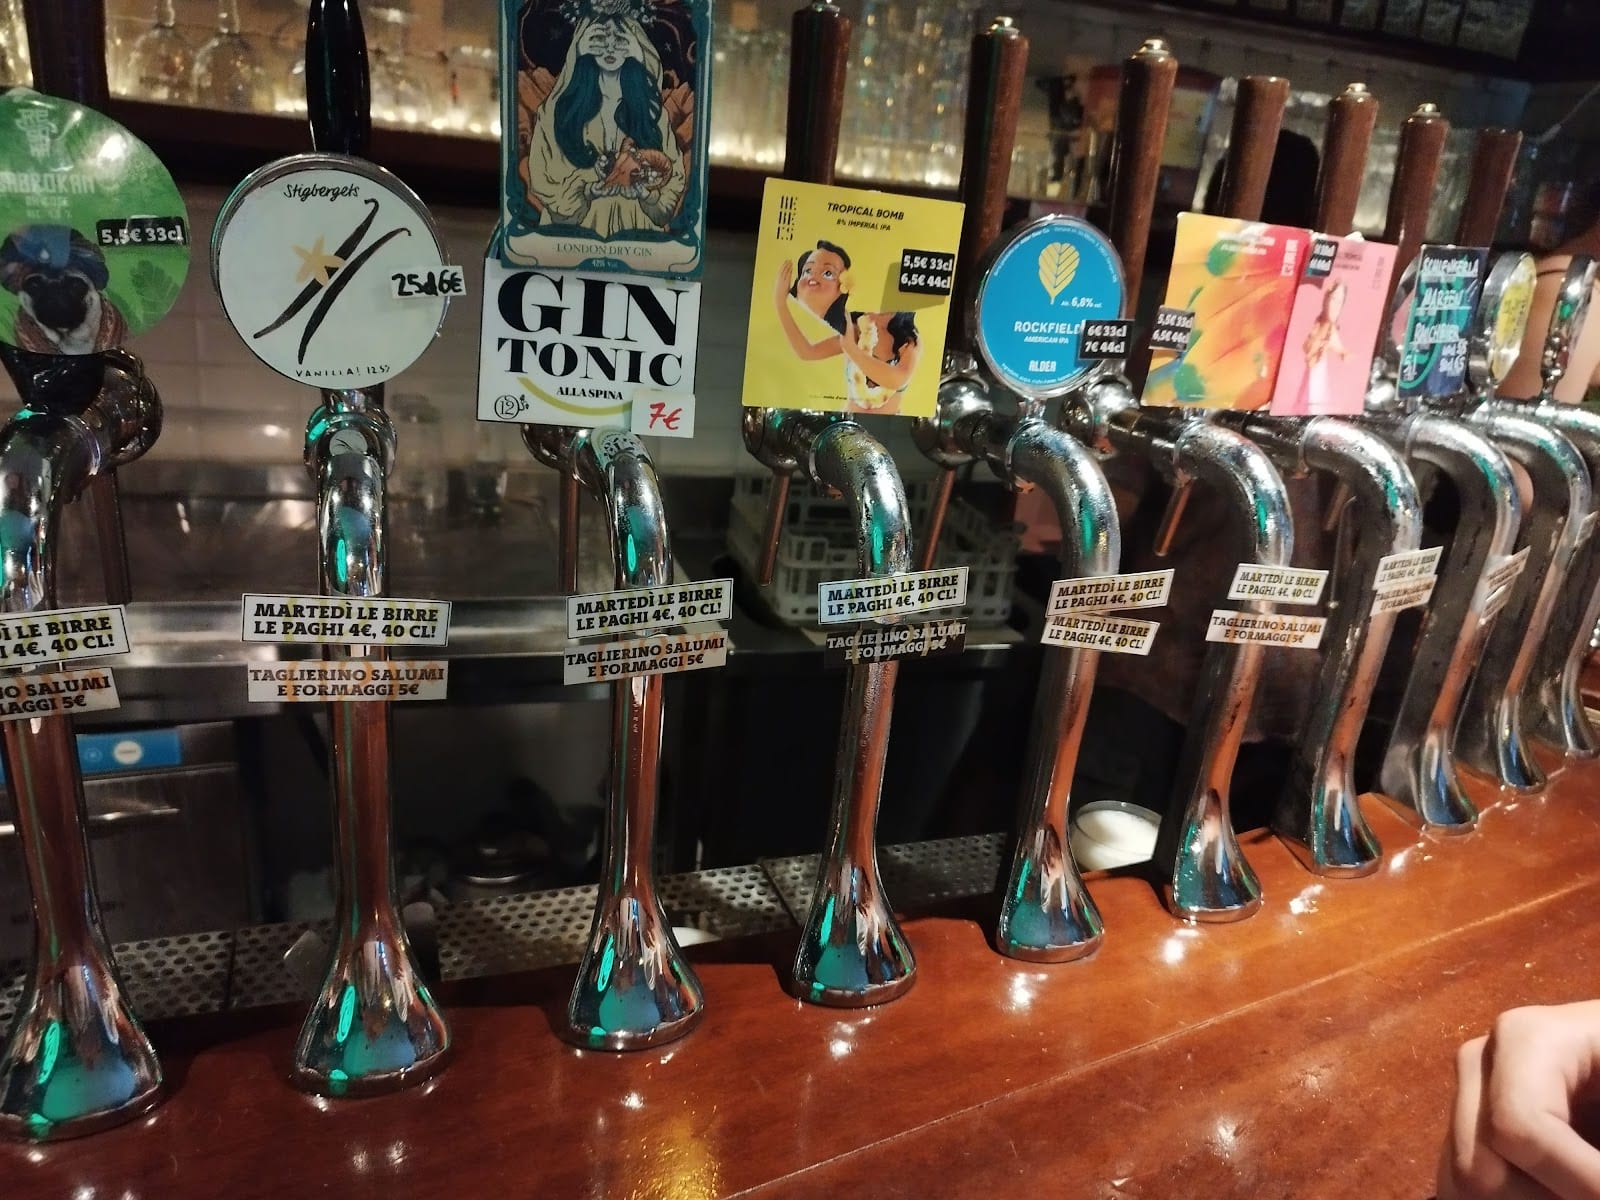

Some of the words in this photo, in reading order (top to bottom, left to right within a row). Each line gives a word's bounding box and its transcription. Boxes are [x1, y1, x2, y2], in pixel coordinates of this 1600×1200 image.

[283, 183, 360, 201] Stigbergets
[827, 202, 873, 217] TROPICAL
[876, 209, 904, 220] BOMB
[848, 219, 878, 230] IMPERIAL
[101, 228, 142, 245] 5,5€
[145, 225, 183, 241] 33cl
[557, 243, 607, 255] LONDON
[609, 246, 631, 256] DRY
[634, 247, 653, 257] GIN
[903, 255, 928, 269] 5,5€
[929, 257, 953, 271] 33cl
[901, 273, 926, 286] 6,5€
[927, 275, 951, 289] 44cl
[498, 271, 690, 346] GIN
[1071, 297, 1094, 308] 6,8%
[1024, 335, 1058, 343] AMERICAN
[1059, 336, 1069, 344] IPA
[1087, 325, 1102, 336] 6€
[1103, 325, 1127, 337] 33cl
[1085, 341, 1098, 352] 7€
[1099, 341, 1125, 353] 44cl
[497, 337, 683, 387] TONIC
[1028, 360, 1056, 372] ALDER
[588, 388, 623, 401] SPINA
[649, 402, 682, 431] 7€
[827, 580, 897, 601] MARTEDÌ
[900, 580, 915, 593] LE
[918, 575, 959, 590] BIRRE
[1057, 579, 1115, 597] MARTEDÌ
[1116, 581, 1130, 591] LE
[1133, 577, 1165, 590] BIRRE
[1236, 584, 1246, 593] LE
[1248, 584, 1276, 596] PAGHI
[1284, 576, 1295, 585] LE
[1295, 576, 1320, 587] BIRRE
[576, 591, 655, 616] MARTEDÌ
[658, 593, 675, 606] LE
[678, 587, 723, 603] BIRRE
[827, 604, 845, 616] LE
[848, 598, 892, 614] PAGHI
[895, 595, 915, 607] 4€,
[918, 592, 934, 604] 40
[937, 589, 957, 601] CL!
[1055, 600, 1068, 609] LE
[1070, 596, 1107, 608] PAGHI
[1110, 594, 1127, 604] 4€,
[1130, 592, 1144, 602] 40
[1145, 590, 1161, 600] CL!
[254, 601, 352, 619] MARTEDÌ
[357, 607, 378, 620] LE
[382, 607, 439, 622] BIRRE
[577, 618, 595, 631] LE
[598, 611, 648, 628] PAGHI
[652, 608, 675, 621] 4€,
[678, 605, 697, 618] 40
[700, 602, 721, 615] CL!
[15, 624, 42, 639] LE
[45, 616, 112, 636] BIRRE
[254, 621, 277, 634] LE
[281, 621, 344, 636] PAGHI
[349, 624, 377, 639] 4€,
[381, 625, 405, 638] 40
[409, 625, 436, 638] CL!
[1105, 623, 1118, 633] LE
[1119, 625, 1150, 637] BIRRE
[1212, 616, 1278, 629] TAGLIERINO
[1280, 621, 1322, 633] SALUMI
[827, 630, 910, 649] TAGLIERINO
[913, 624, 966, 639] SALUMI
[1048, 629, 1062, 639] LE
[1063, 630, 1097, 644] PAGHI
[1098, 635, 1112, 646] 4€,
[1115, 637, 1128, 646] 40
[1129, 639, 1144, 649] CL!
[1224, 629, 1231, 638] E
[1232, 630, 1291, 642] FORMAGGI
[13, 642, 47, 656] 4€,
[51, 638, 78, 652] 40
[82, 634, 115, 649] CL!
[566, 644, 664, 665] TAGLIERINO
[666, 637, 725, 654] SALUMI
[845, 649, 853, 660] E
[856, 641, 928, 659] FORMAGGI
[250, 669, 366, 681] TAGLIERINO
[371, 668, 445, 681] SALUMI
[587, 666, 596, 677] E
[600, 656, 683, 675] FORMAGGI
[687, 654, 704, 666] 5€
[25, 676, 111, 697] SALUMI
[277, 685, 287, 696] E
[292, 684, 394, 696] FORMAGGI
[399, 683, 419, 695] 5€
[0, 698, 58, 716] AGGI
[62, 694, 87, 708] 5€
